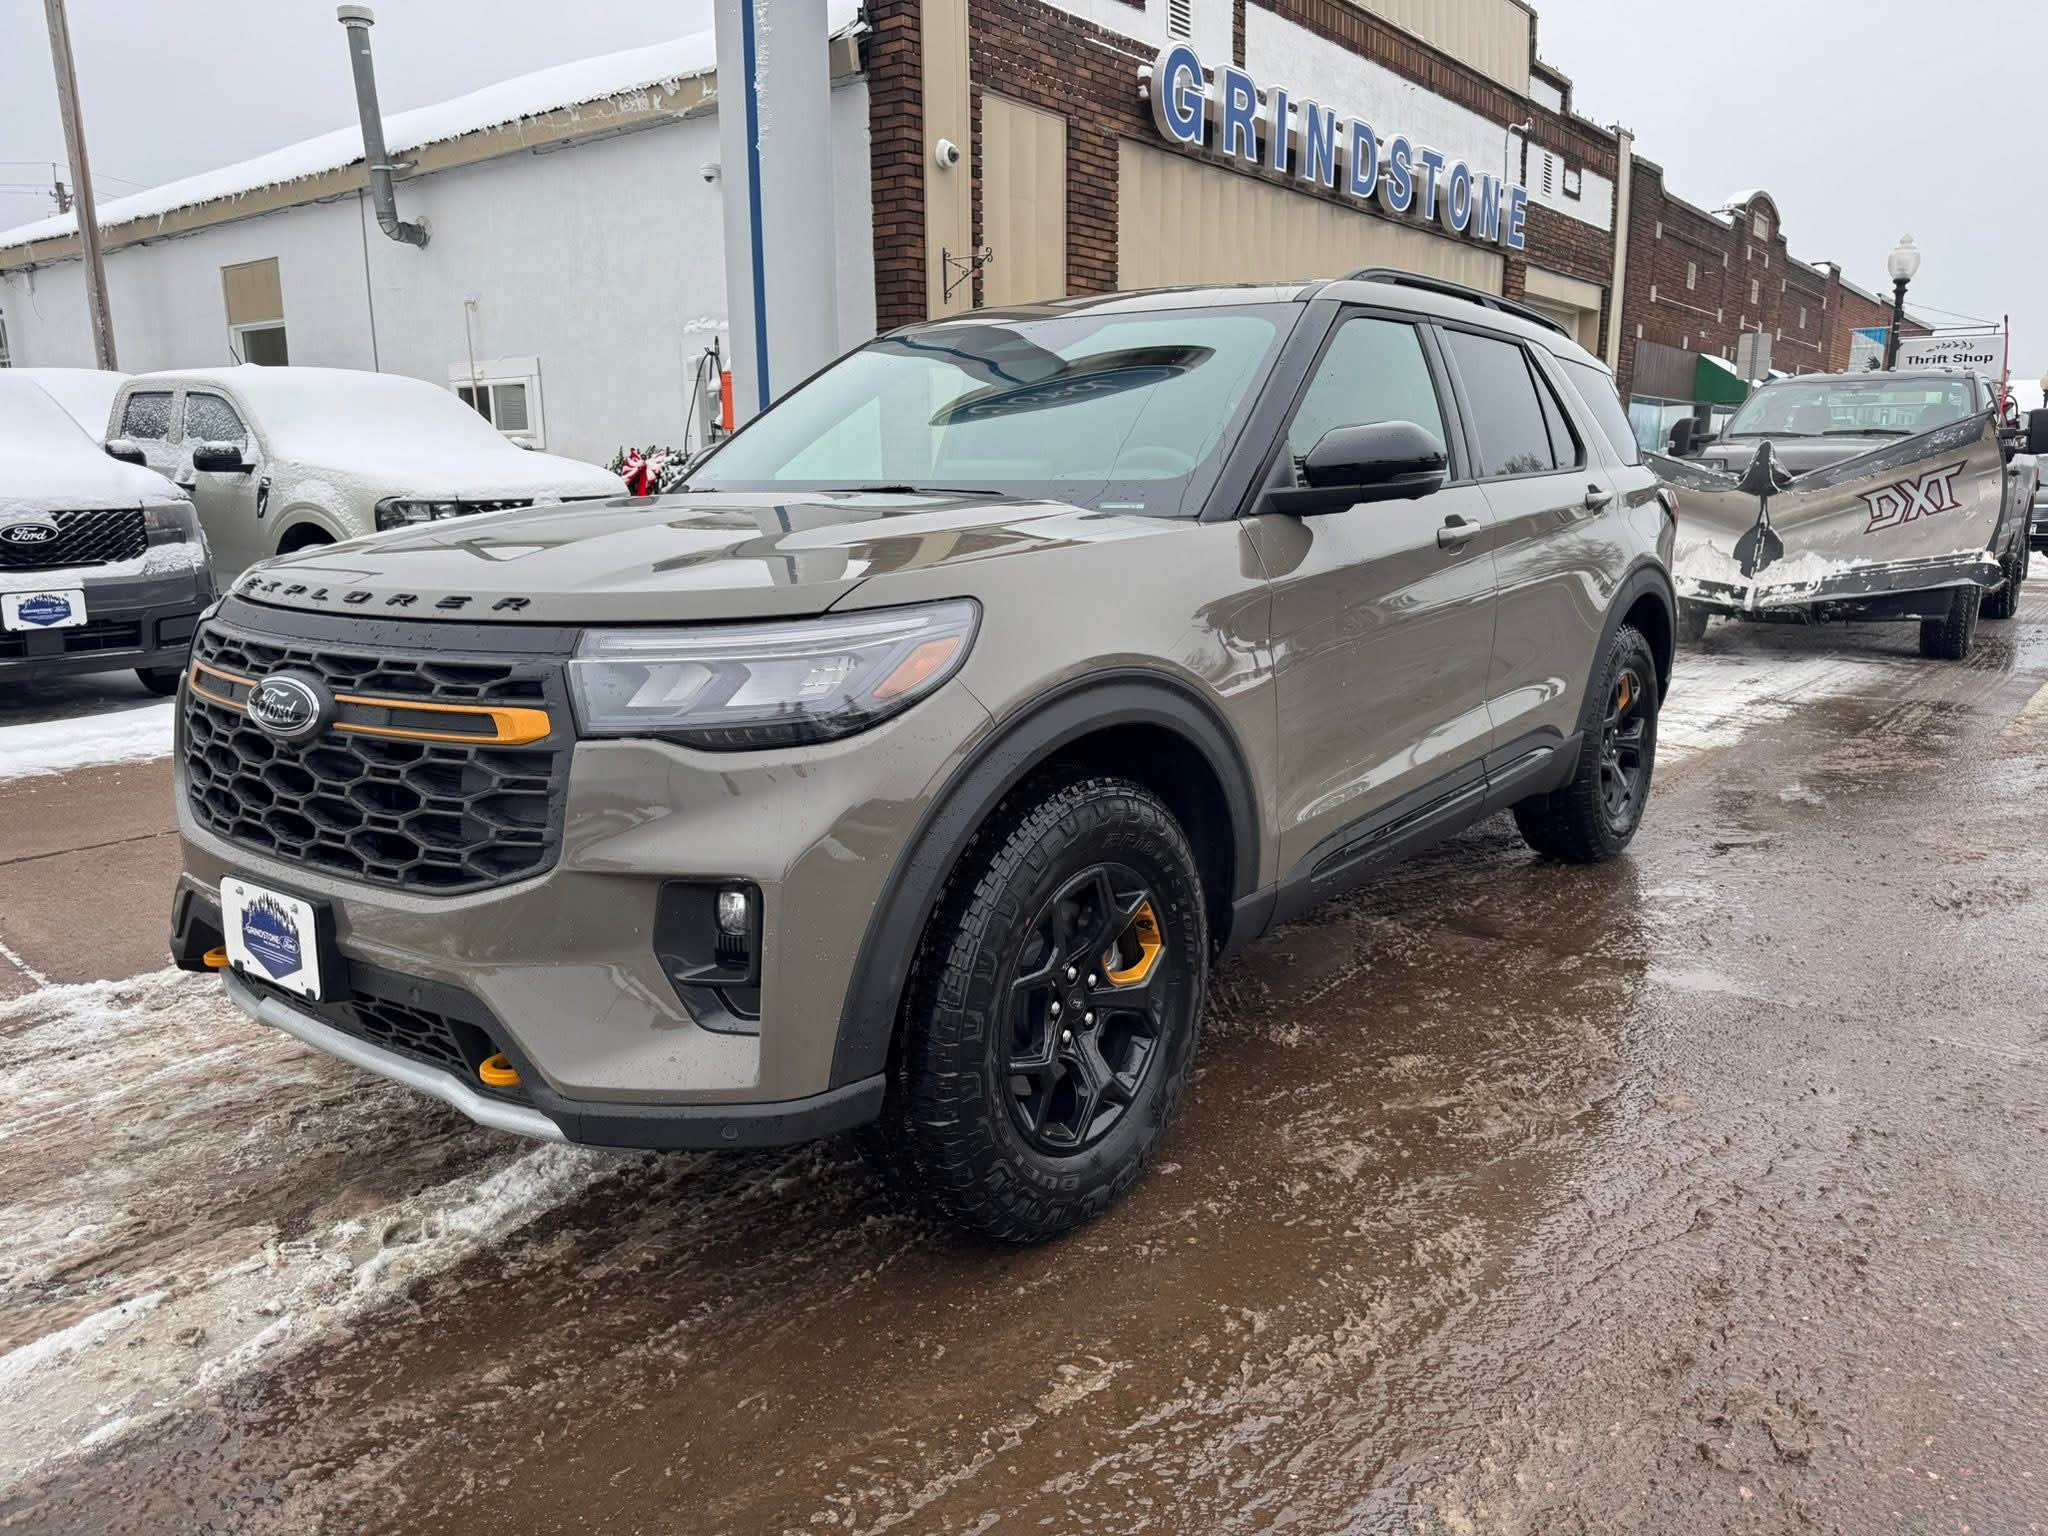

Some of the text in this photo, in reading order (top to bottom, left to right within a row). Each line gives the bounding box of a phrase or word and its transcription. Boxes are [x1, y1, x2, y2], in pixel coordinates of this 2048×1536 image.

[1153, 41, 1529, 251] GRINDSTONE
[1906, 352, 1994, 366] Thrift Shop
[1856, 459, 1968, 535] DXT
[11, 526, 48, 541] Ford
[242, 575, 532, 613] EXPLORER
[258, 687, 298, 723] Ford
